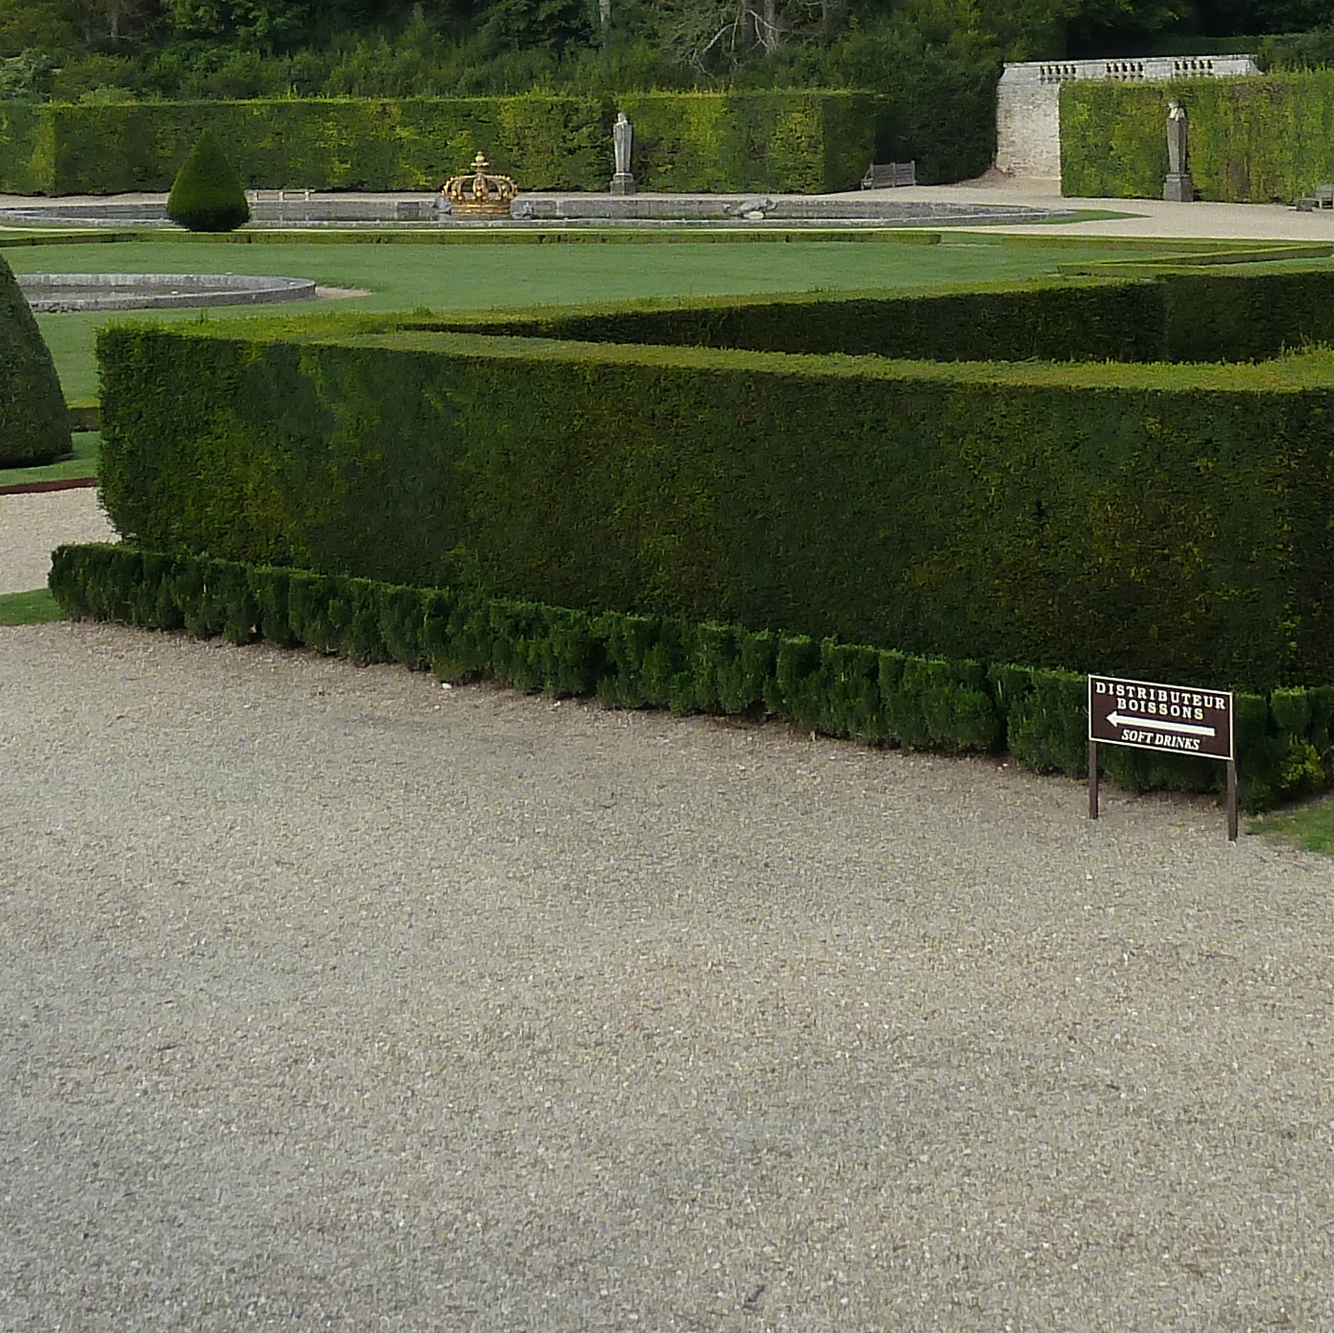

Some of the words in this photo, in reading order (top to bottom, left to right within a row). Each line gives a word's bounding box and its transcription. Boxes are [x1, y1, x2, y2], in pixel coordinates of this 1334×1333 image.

[1095, 681, 1226, 710] DISTRIBUTEUR
[1117, 697, 1204, 720] BOISSONS
[1121, 729, 1154, 744] SOFT
[1154, 733, 1201, 750] DRINKS
